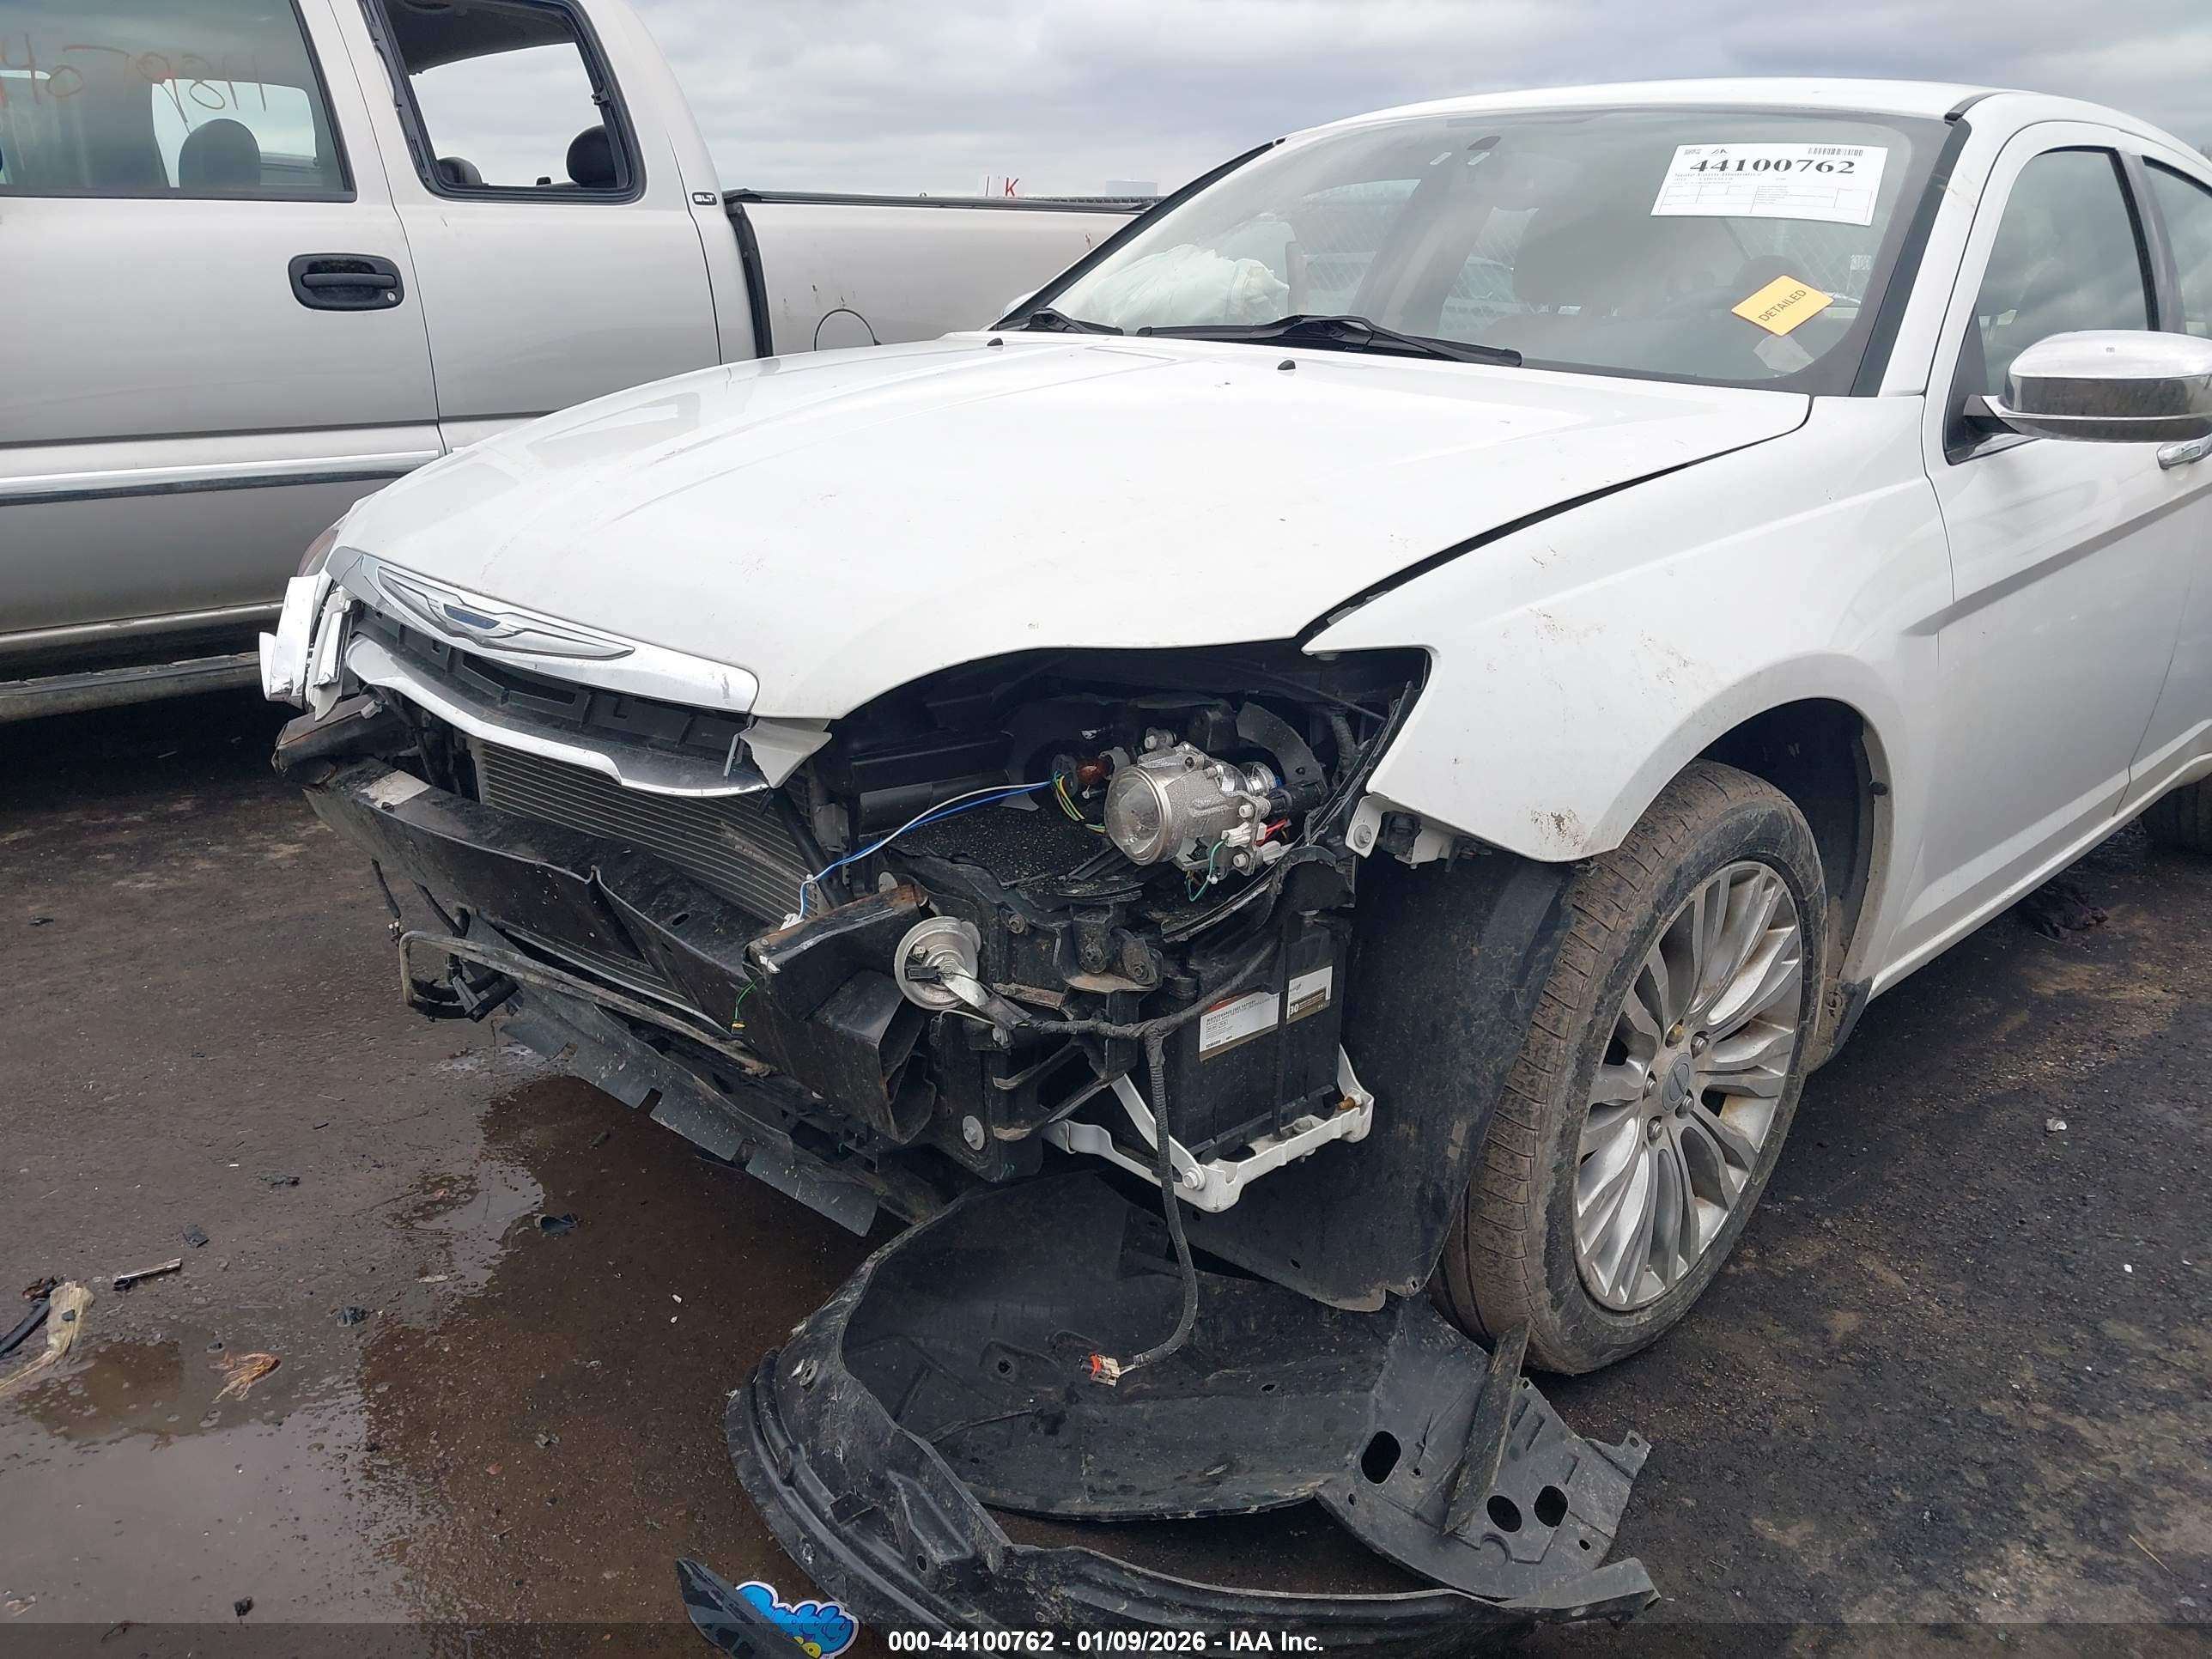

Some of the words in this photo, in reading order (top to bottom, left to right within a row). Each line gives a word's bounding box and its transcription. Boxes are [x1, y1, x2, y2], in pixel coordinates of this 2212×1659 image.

[1690, 158, 1856, 174] 44100762
[1004, 177, 1019, 197] K
[693, 194, 714, 203] SLT
[1758, 289, 1807, 322] DETAILED
